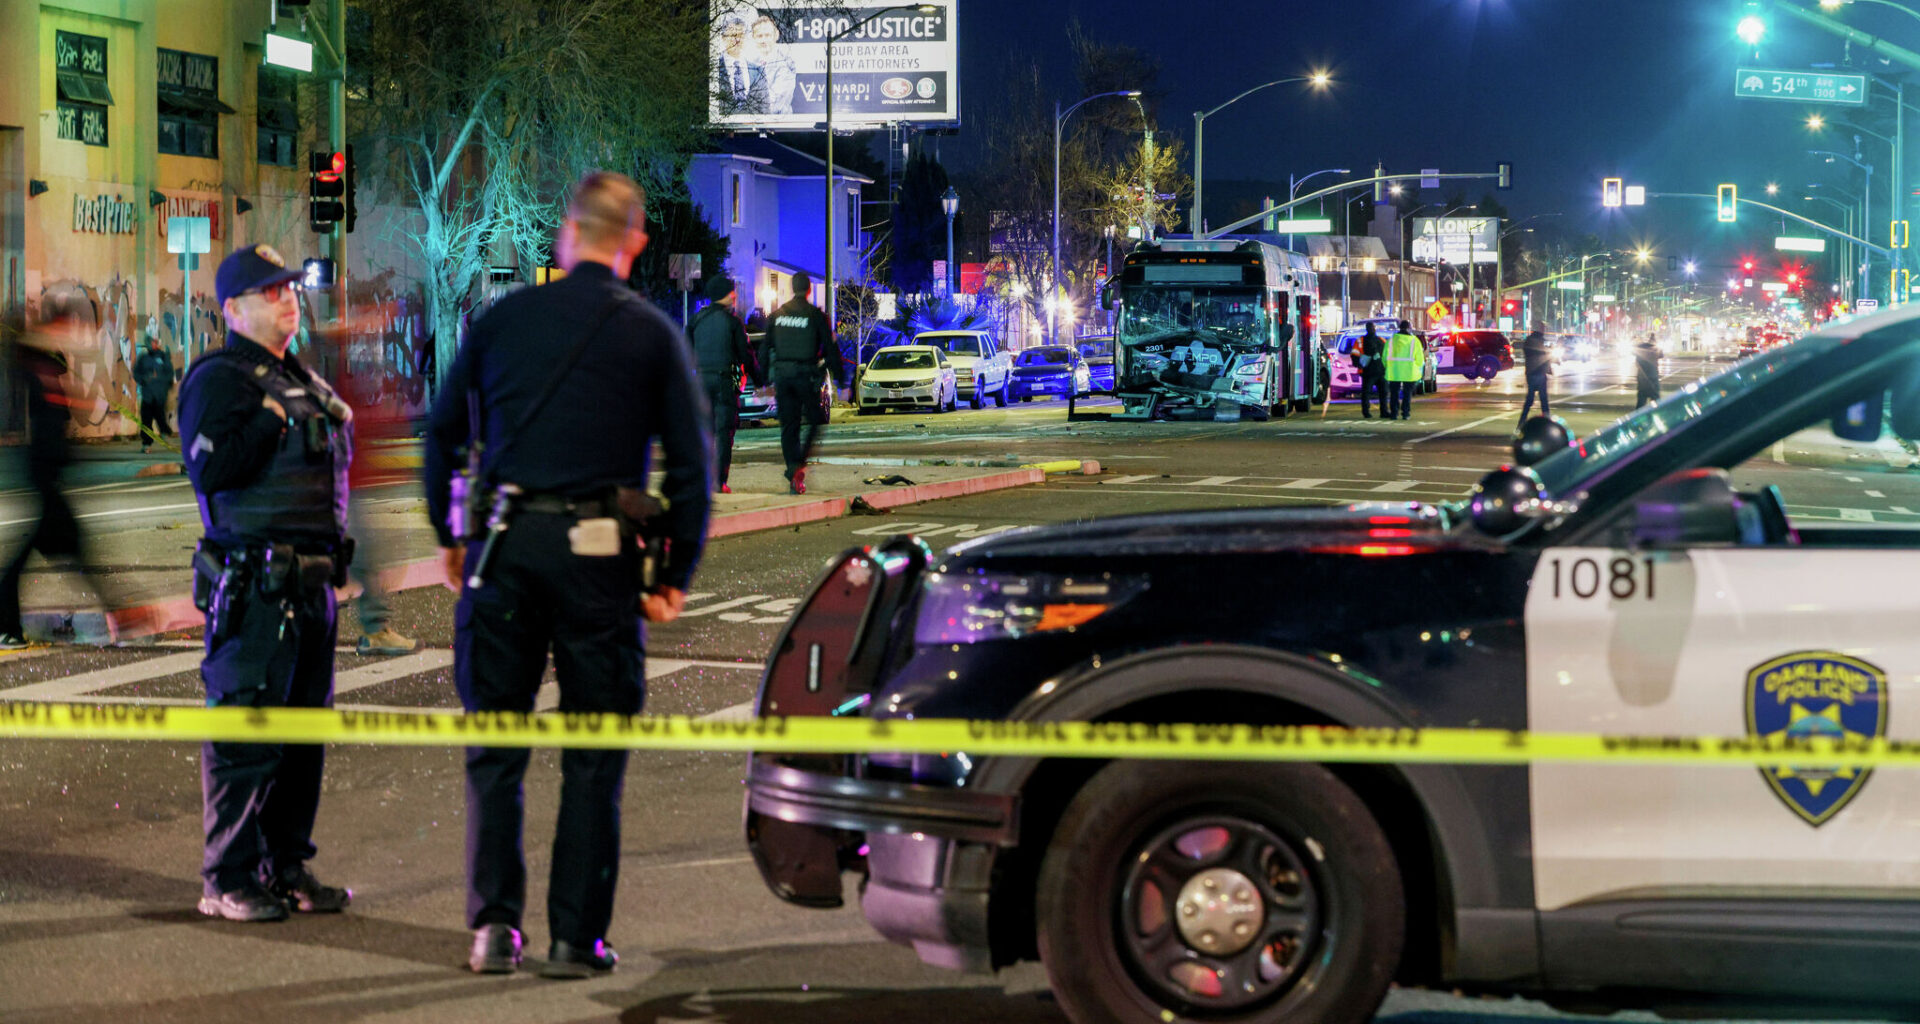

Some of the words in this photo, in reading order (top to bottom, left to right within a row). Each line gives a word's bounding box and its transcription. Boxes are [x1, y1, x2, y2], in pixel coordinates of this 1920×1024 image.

[794, 18, 850, 39] 1-800
[823, 46, 853, 56] YOUR
[857, 45, 879, 55] BAY
[880, 45, 909, 55] AREA
[815, 58, 855, 69] INURY
[857, 58, 920, 69] ATTORNEYS
[818, 83, 870, 94] VNARDI
[1771, 76, 1808, 94] 54th
[1815, 77, 1834, 88] Ave
[1814, 88, 1836, 98] 1300
[775, 315, 809, 328] POLICE
[1145, 344, 1164, 352] 2301
[1176, 351, 1218, 363] TEMPO
[1551, 557, 1654, 599] 1081
[1763, 662, 1869, 693] OAKLAND
[1776, 680, 1855, 705] POLICE
